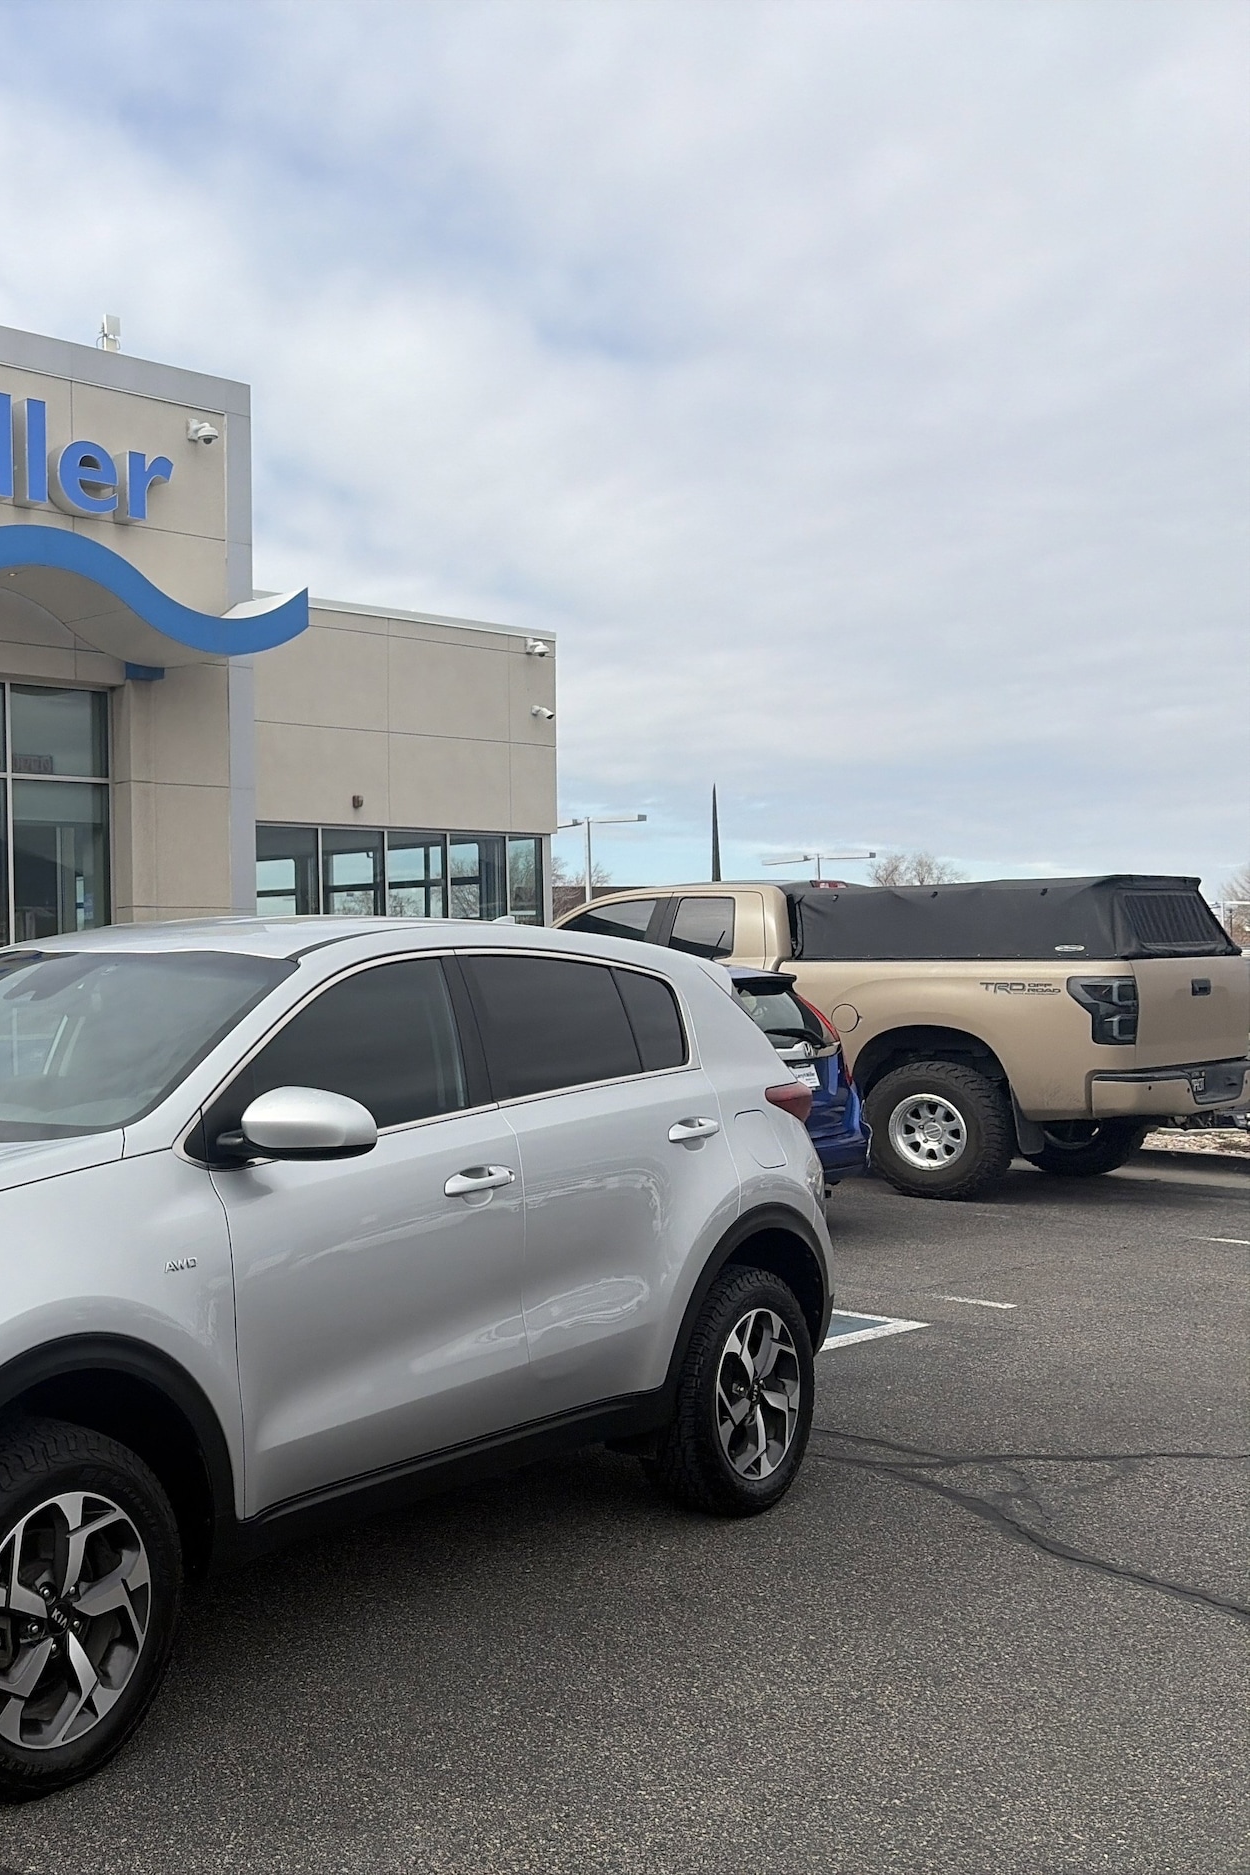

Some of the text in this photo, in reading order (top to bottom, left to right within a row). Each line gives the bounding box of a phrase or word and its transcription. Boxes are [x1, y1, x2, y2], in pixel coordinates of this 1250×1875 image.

[979, 982, 1027, 995] TRD
[164, 1256, 198, 1273] AWD
[51, 1607, 68, 1629] KIA
